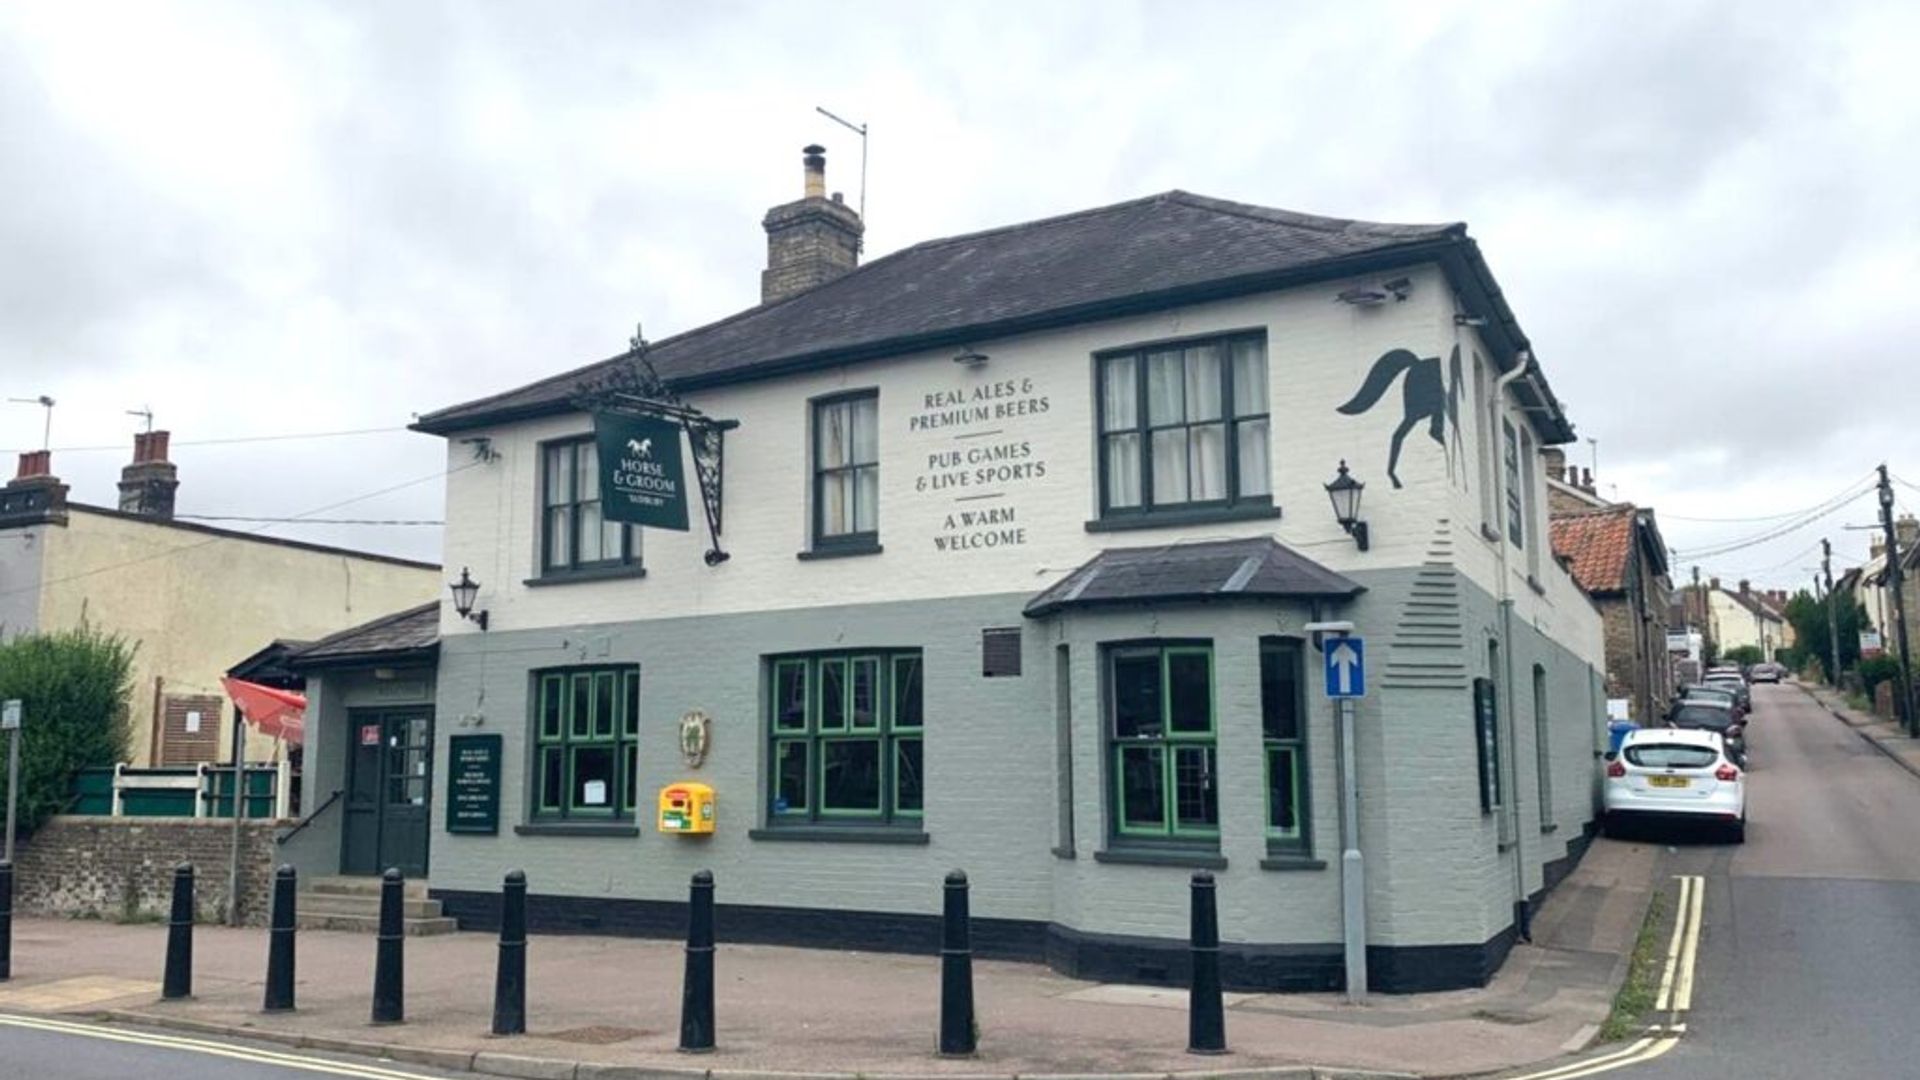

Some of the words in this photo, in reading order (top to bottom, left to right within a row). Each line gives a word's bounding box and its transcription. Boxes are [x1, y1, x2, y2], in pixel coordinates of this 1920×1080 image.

[924, 390, 966, 408] REAL
[972, 380, 1015, 400] ALES
[1022, 378, 1033, 393] &
[910, 406, 989, 431] PREMIUM
[995, 397, 1050, 419] BEERS
[621, 459, 665, 477] HORSE
[928, 452, 962, 469] PUB
[967, 442, 1031, 463] GAMES
[613, 469, 624, 485] &
[626, 473, 676, 491] GROOM
[915, 476, 927, 492] &
[932, 472, 970, 490] LIVE
[975, 461, 1046, 484] SPORTS
[943, 515, 956, 530] A
[960, 507, 1014, 526] WARM
[934, 528, 1026, 550] WELCOME
